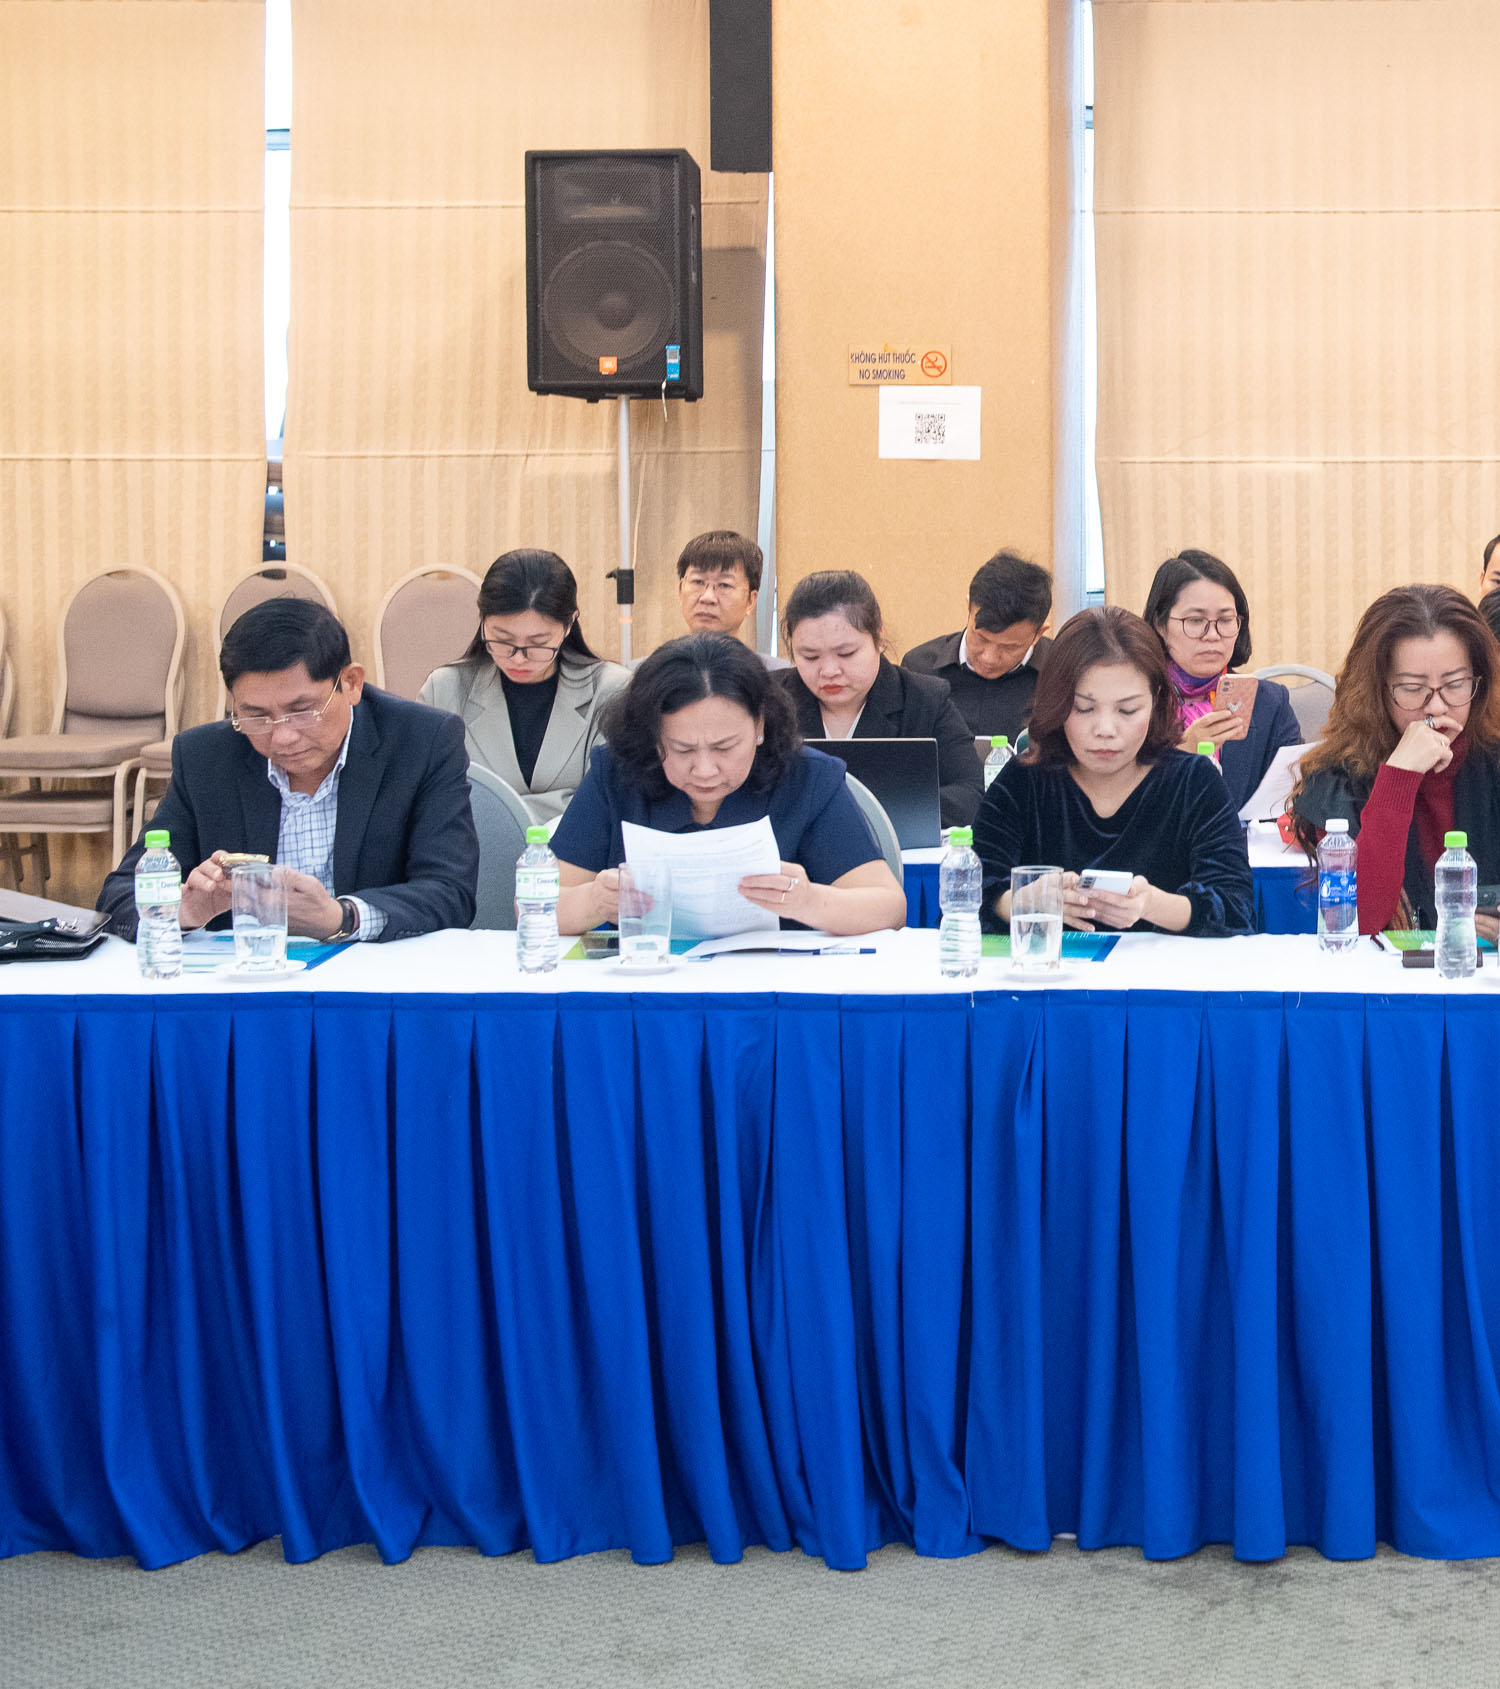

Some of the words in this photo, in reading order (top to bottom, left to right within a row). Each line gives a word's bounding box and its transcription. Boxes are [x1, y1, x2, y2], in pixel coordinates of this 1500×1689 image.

[850, 350, 877, 364] KHÔNG
[859, 368, 871, 380] NO
[872, 368, 906, 380] SMOKING
